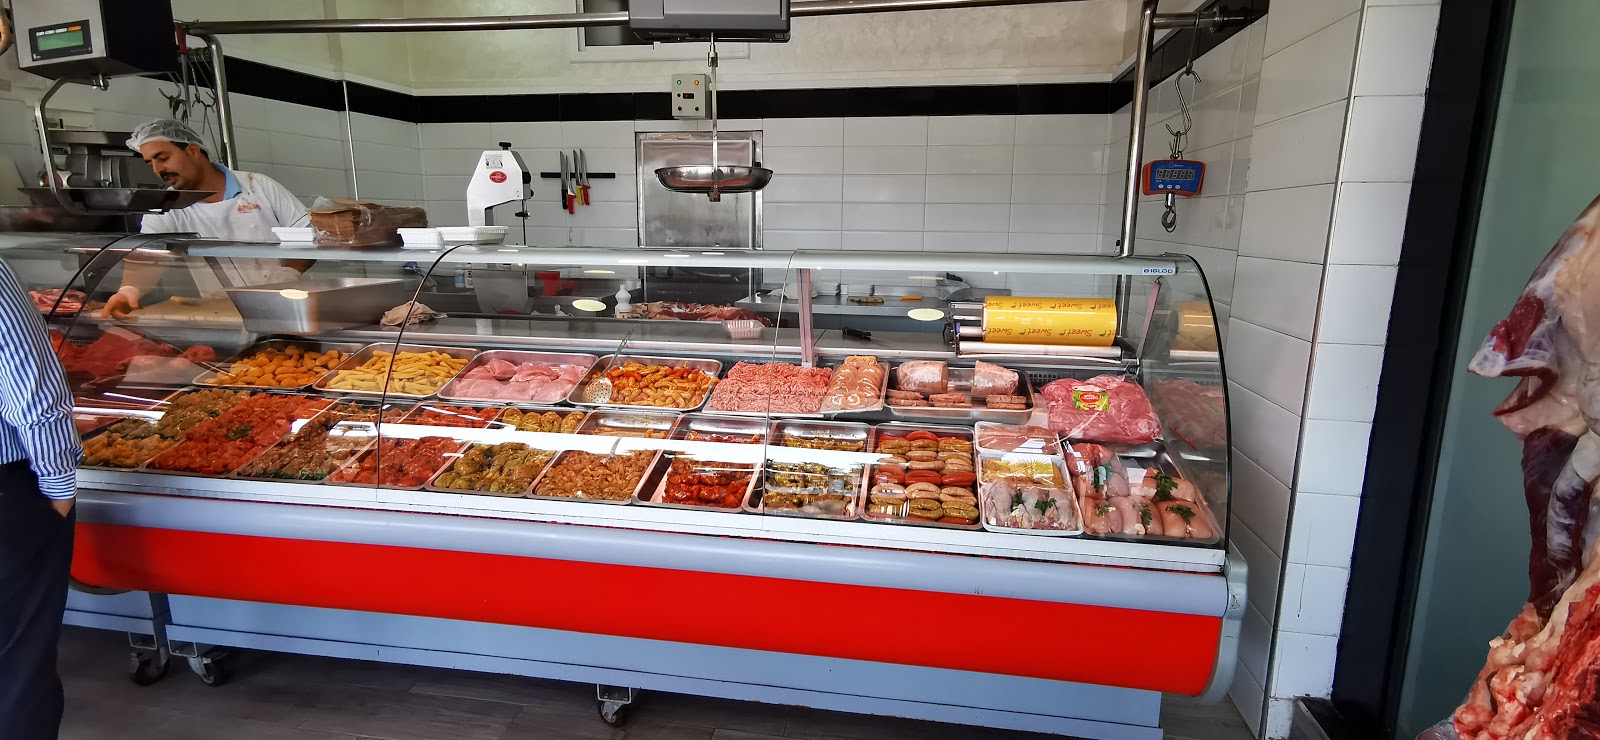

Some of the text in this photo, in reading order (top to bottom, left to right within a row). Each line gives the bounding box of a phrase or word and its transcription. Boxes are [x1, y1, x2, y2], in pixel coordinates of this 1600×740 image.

[1018, 302, 1043, 310] Sweet
[1057, 302, 1083, 310] Sweet
[988, 327, 1093, 337] Sweet Sweet Sweet
